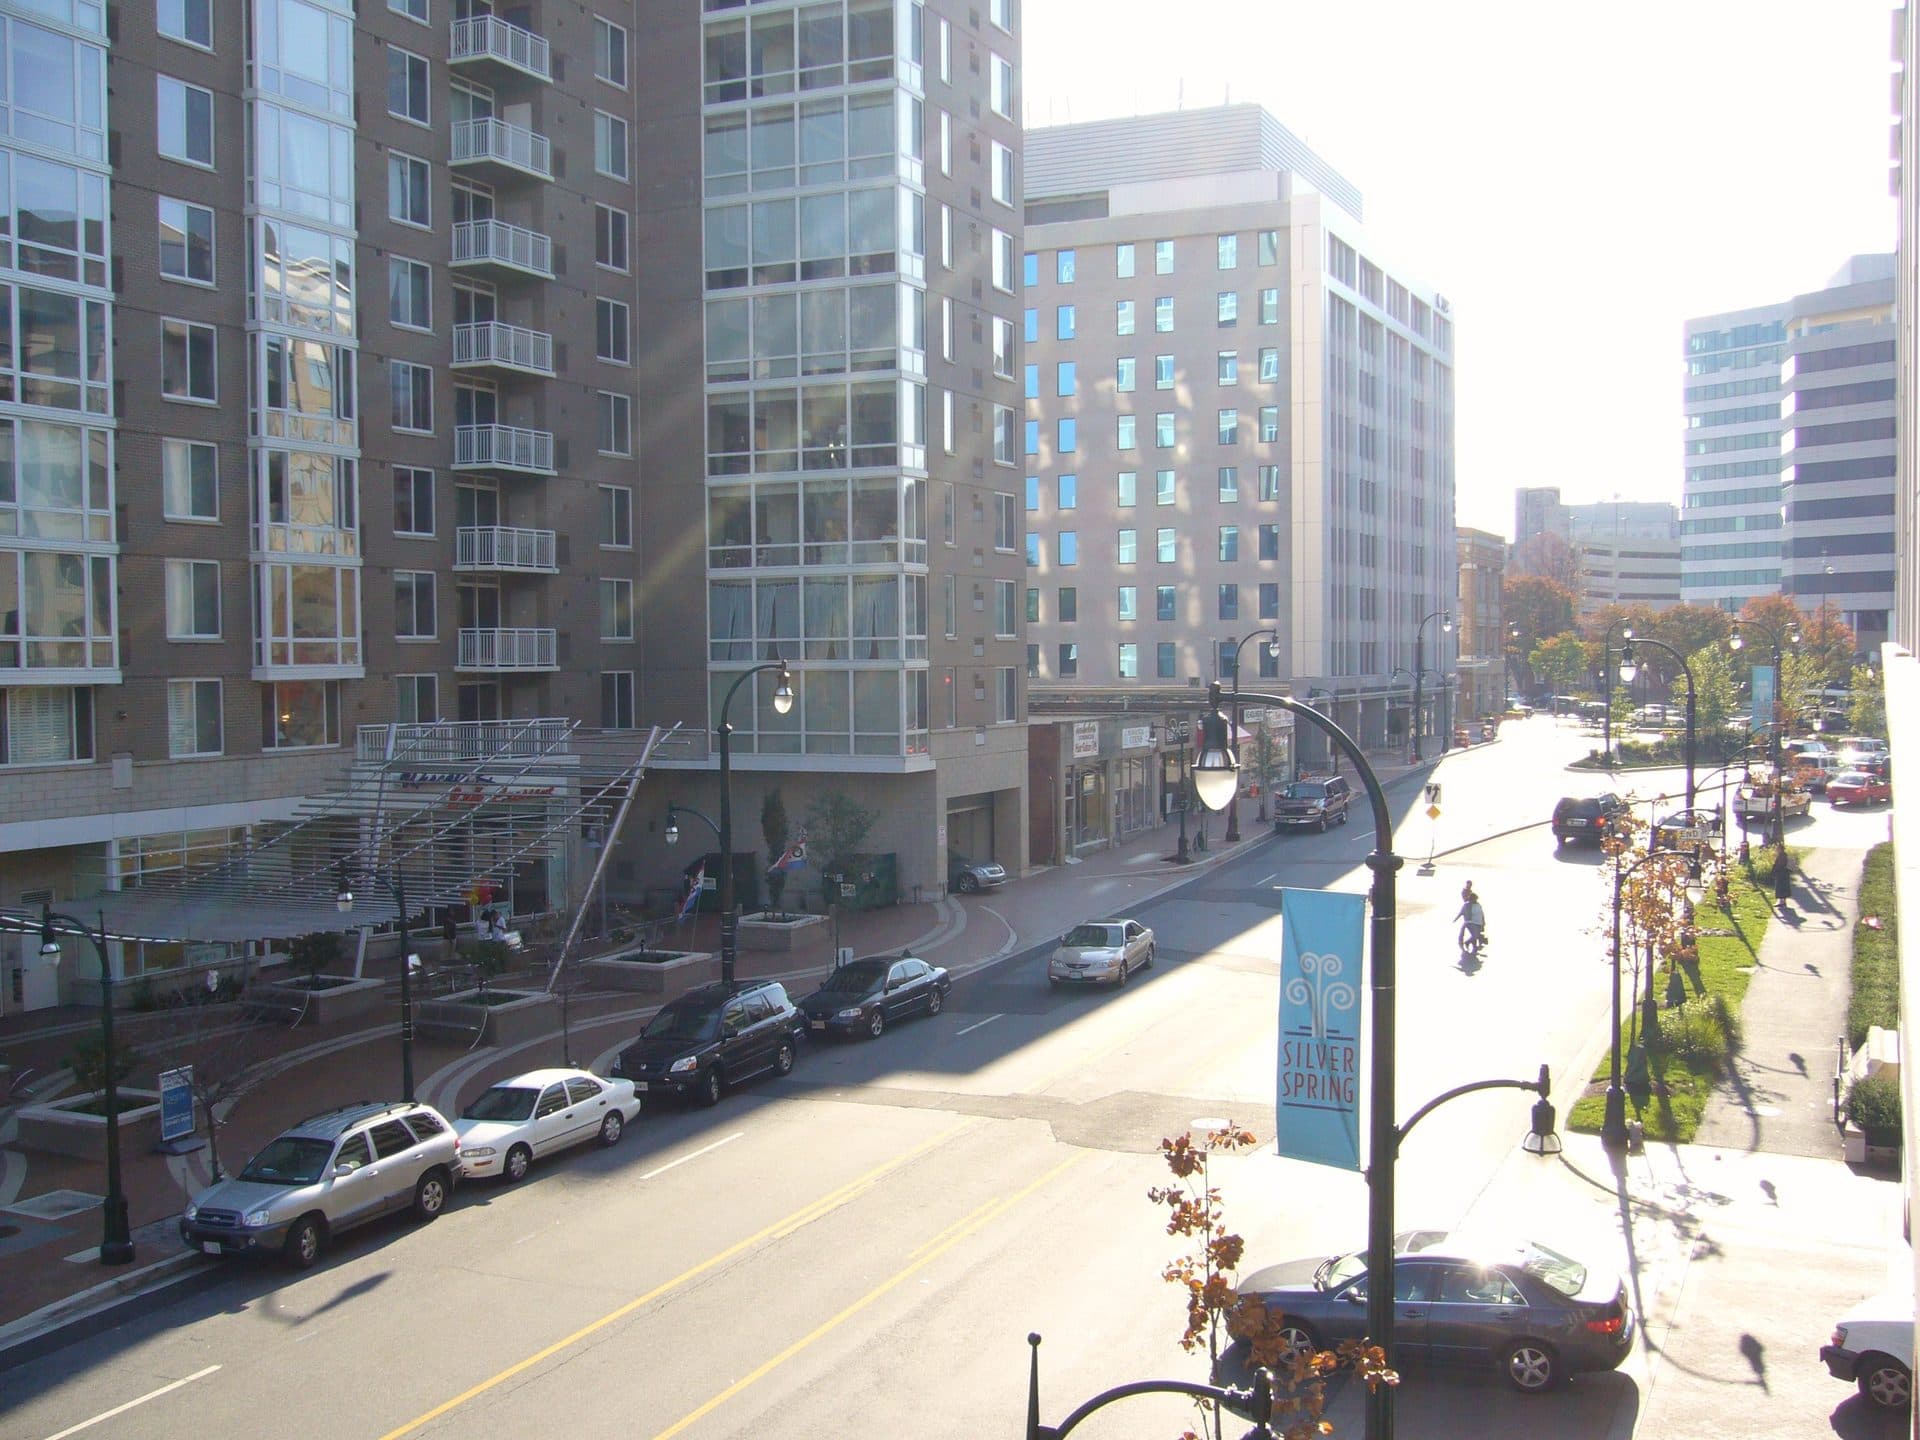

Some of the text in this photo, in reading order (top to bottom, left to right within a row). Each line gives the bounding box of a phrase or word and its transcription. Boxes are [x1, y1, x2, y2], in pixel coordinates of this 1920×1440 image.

[1681, 830, 1698, 838] END
[1282, 1041, 1354, 1073] SILVER
[1282, 1071, 1354, 1104] SPRING
